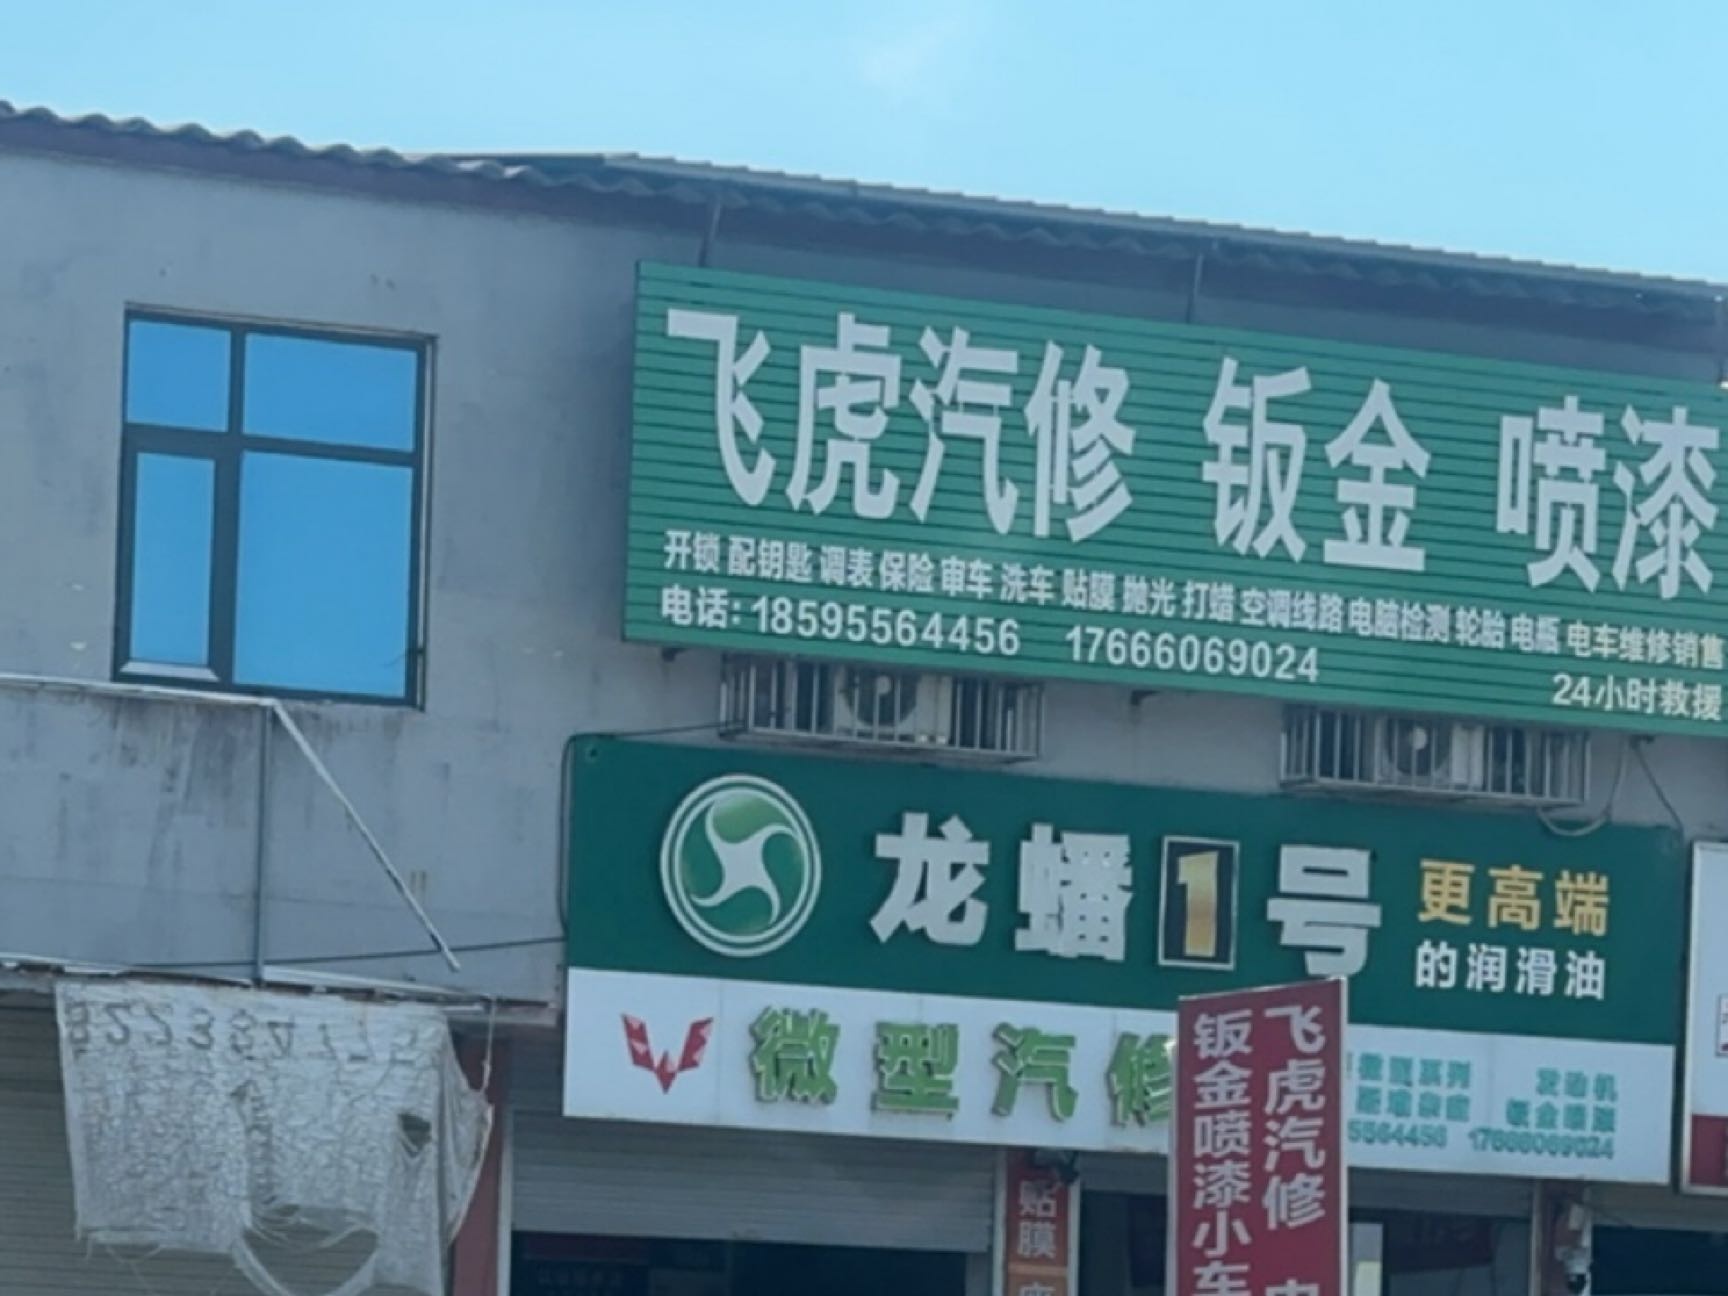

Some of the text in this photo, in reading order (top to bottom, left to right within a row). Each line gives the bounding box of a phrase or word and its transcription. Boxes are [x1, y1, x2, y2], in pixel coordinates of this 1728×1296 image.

[666, 308, 1721, 599] 飞虎汽修 钣金 喷漆
[664, 529, 1724, 670] 开锁 配钥匙 调表 保险 审车 洗车 贴膜 抛光 打蜡 空调线路 电脑检测 轮胎 电瓶 电车维修销售
[1065, 624, 1319, 683] 17666069024
[1552, 672, 1722, 721] 24小时救援
[869, 811, 1381, 977] 龙蟠1号
[1419, 857, 1610, 937] 更高端
[1415, 940, 1606, 999] 的润滑油
[749, 1005, 1176, 1128] 微型汽修
[1262, 1005, 1326, 1230] 飞虎汽修
